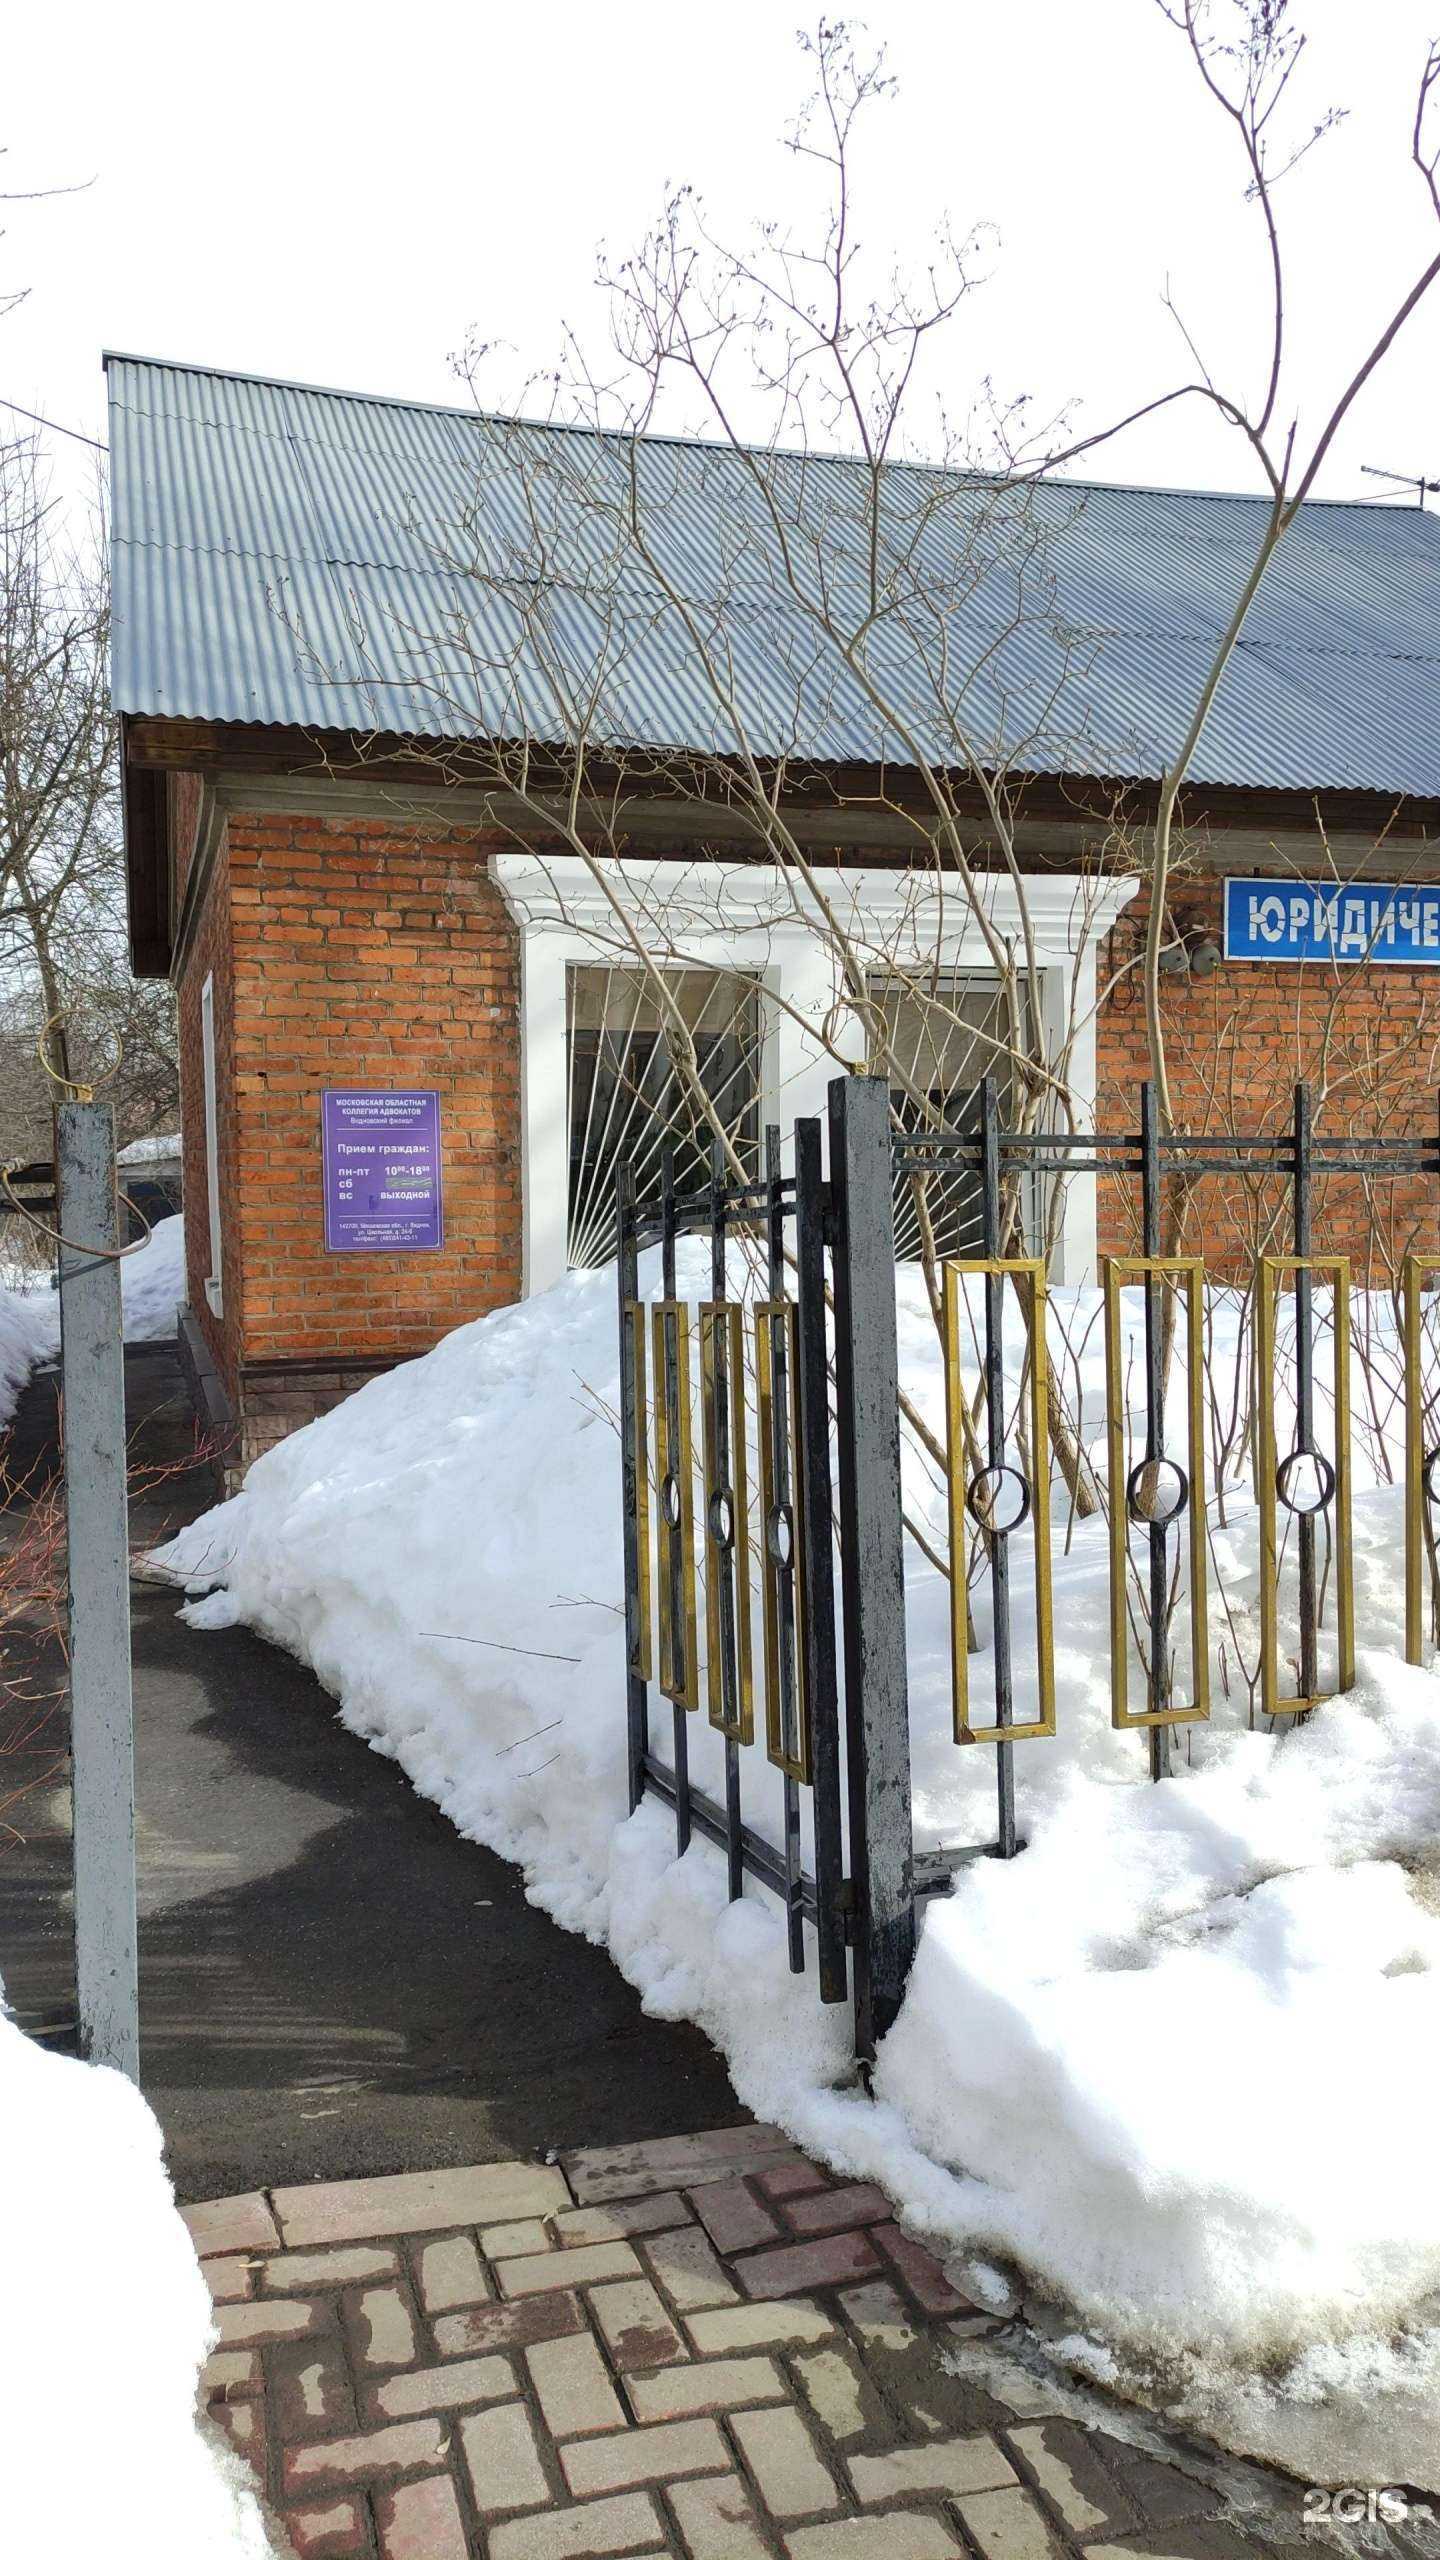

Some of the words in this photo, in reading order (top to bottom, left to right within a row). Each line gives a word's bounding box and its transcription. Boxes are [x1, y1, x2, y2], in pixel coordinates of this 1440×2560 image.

[337, 1143, 375, 1155] Прием
[379, 1144, 429, 1155] граждан:
[338, 1168, 370, 1176] пн-пт
[338, 1178, 353, 1188] сб
[338, 1192, 353, 1200] вс
[380, 1190, 430, 1200] выходной
